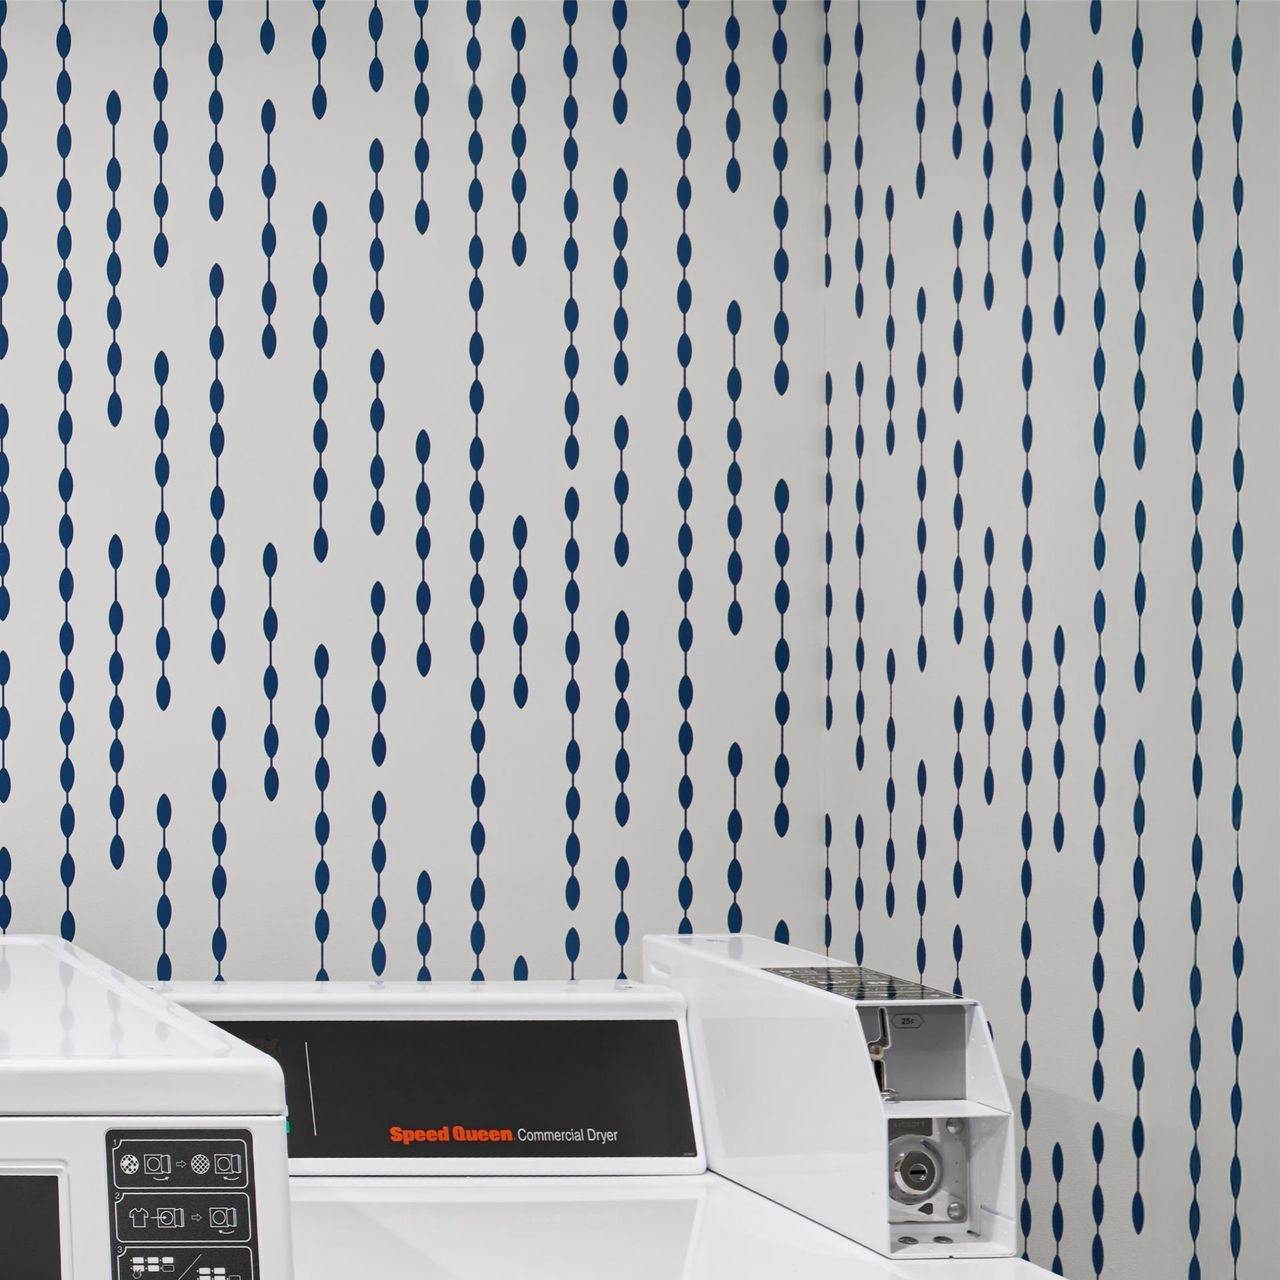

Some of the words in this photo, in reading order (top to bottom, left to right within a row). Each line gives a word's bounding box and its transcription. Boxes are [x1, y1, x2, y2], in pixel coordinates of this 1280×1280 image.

[390, 1127, 449, 1144] Speed
[452, 1126, 512, 1141] Queen
[517, 1128, 585, 1142] Commercial
[587, 1128, 619, 1145] Dryer
